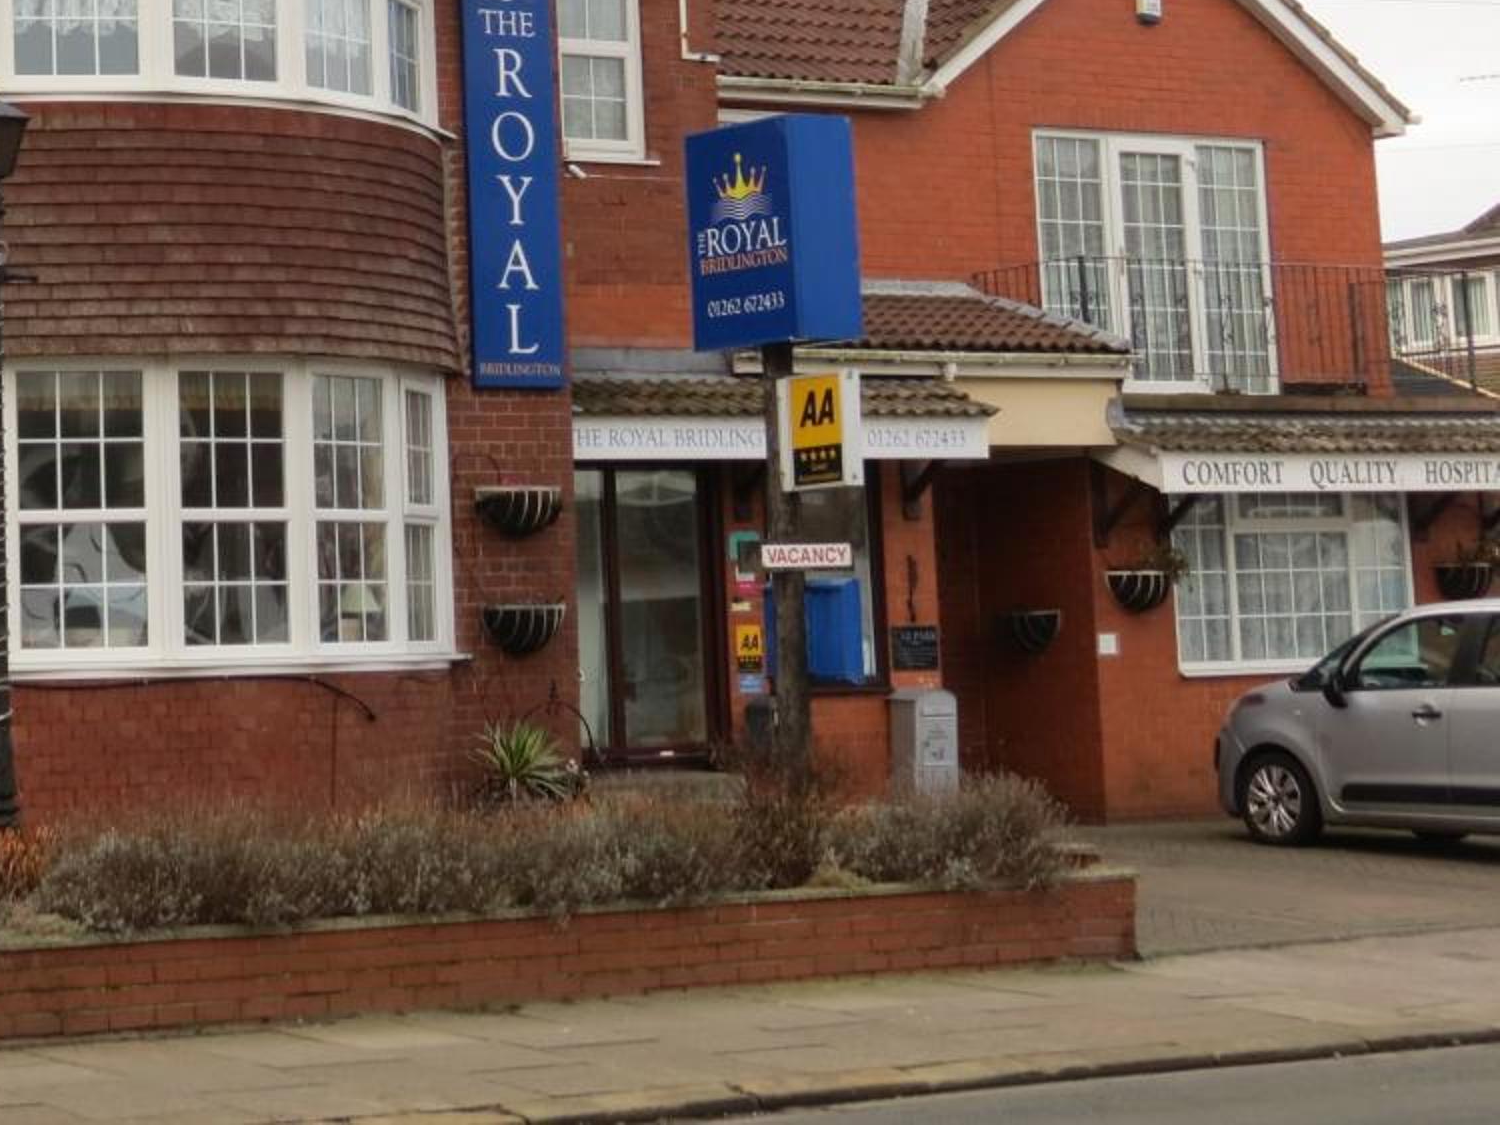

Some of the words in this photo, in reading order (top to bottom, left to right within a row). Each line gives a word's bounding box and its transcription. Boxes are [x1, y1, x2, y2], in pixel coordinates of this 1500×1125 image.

[477, 9, 536, 38] THE
[490, 48, 540, 355] ROYAL
[706, 216, 788, 257] ROYAL
[700, 246, 788, 275] BRIDLINGTON
[707, 297, 741, 318] 01262
[479, 361, 562, 376] BRIDLINGTON
[800, 387, 835, 428] AA
[574, 428, 605, 448] HE
[608, 428, 669, 448] ROYAL
[675, 428, 764, 449] BRIDLING
[1182, 460, 1284, 486] COMFORT
[1309, 459, 1398, 489] QUALITY
[765, 546, 847, 564] VACANCY
[740, 633, 759, 651] AA
